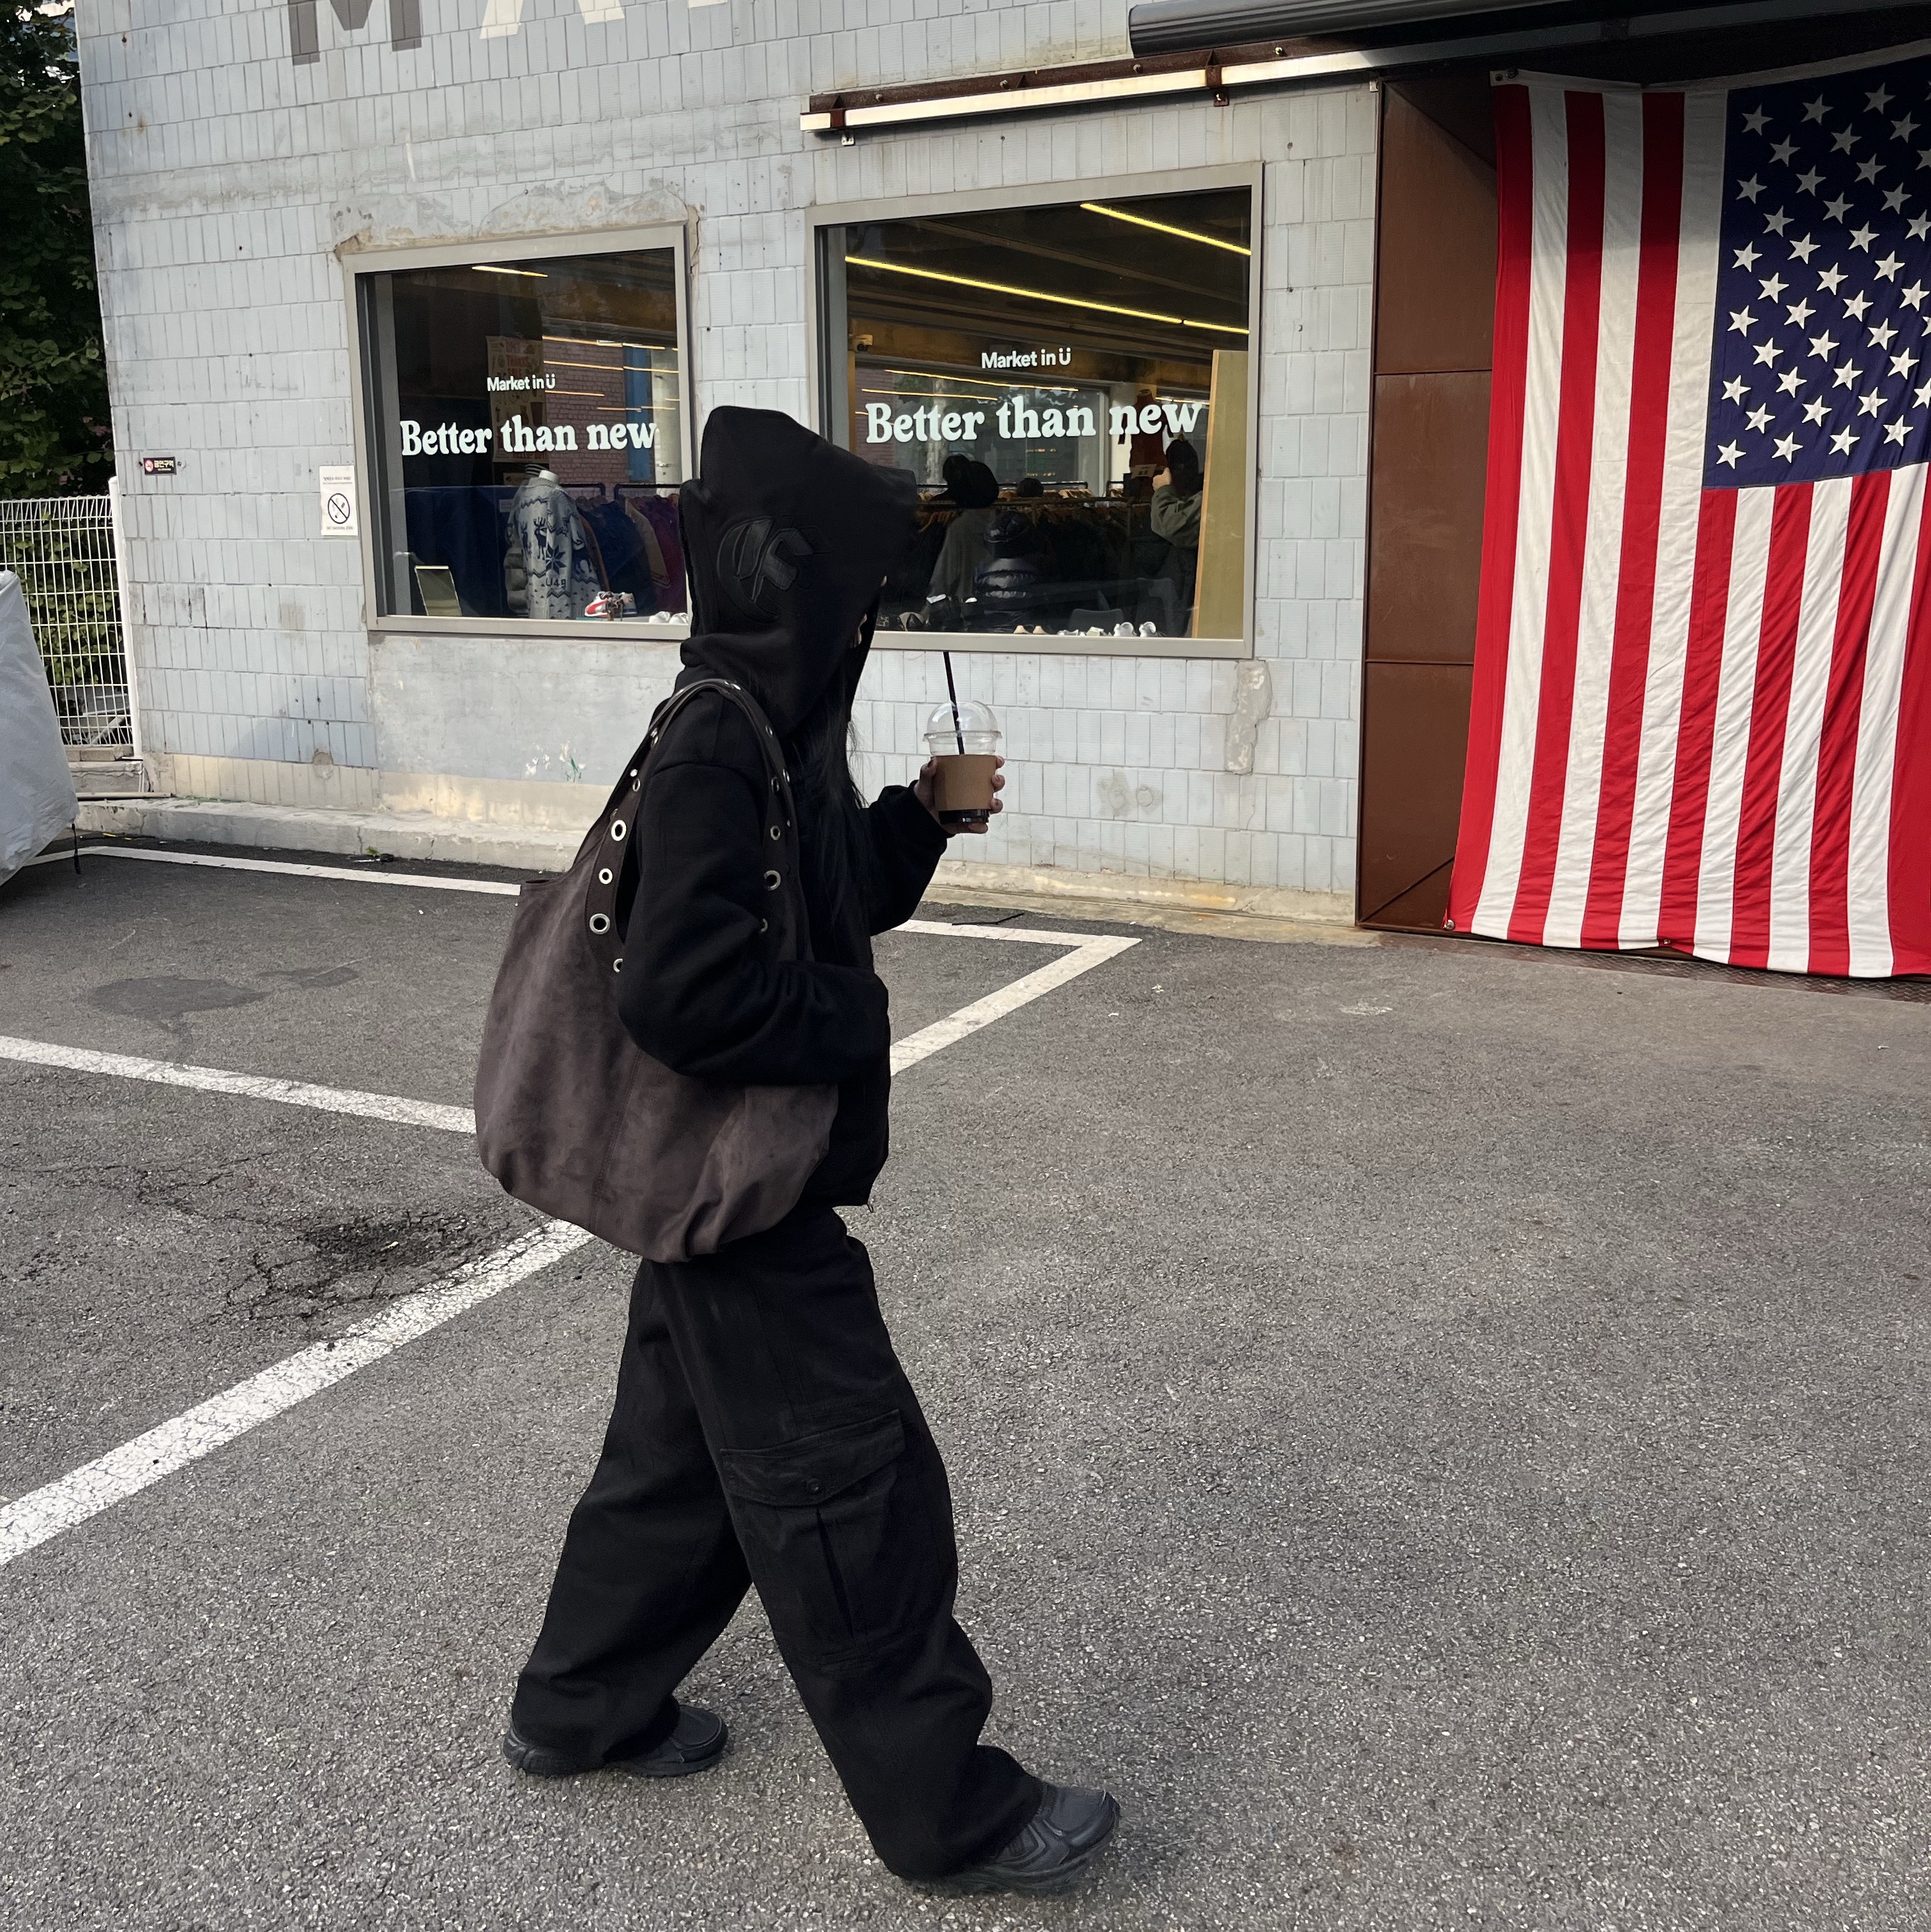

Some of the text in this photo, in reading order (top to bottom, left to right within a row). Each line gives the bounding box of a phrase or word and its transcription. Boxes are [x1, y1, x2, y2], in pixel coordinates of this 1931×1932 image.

[981, 347, 1071, 369] Market in Ü
[487, 376, 531, 392] Market
[533, 374, 545, 390] in
[865, 395, 1201, 443] Better than new
[399, 415, 657, 456] Better than new
